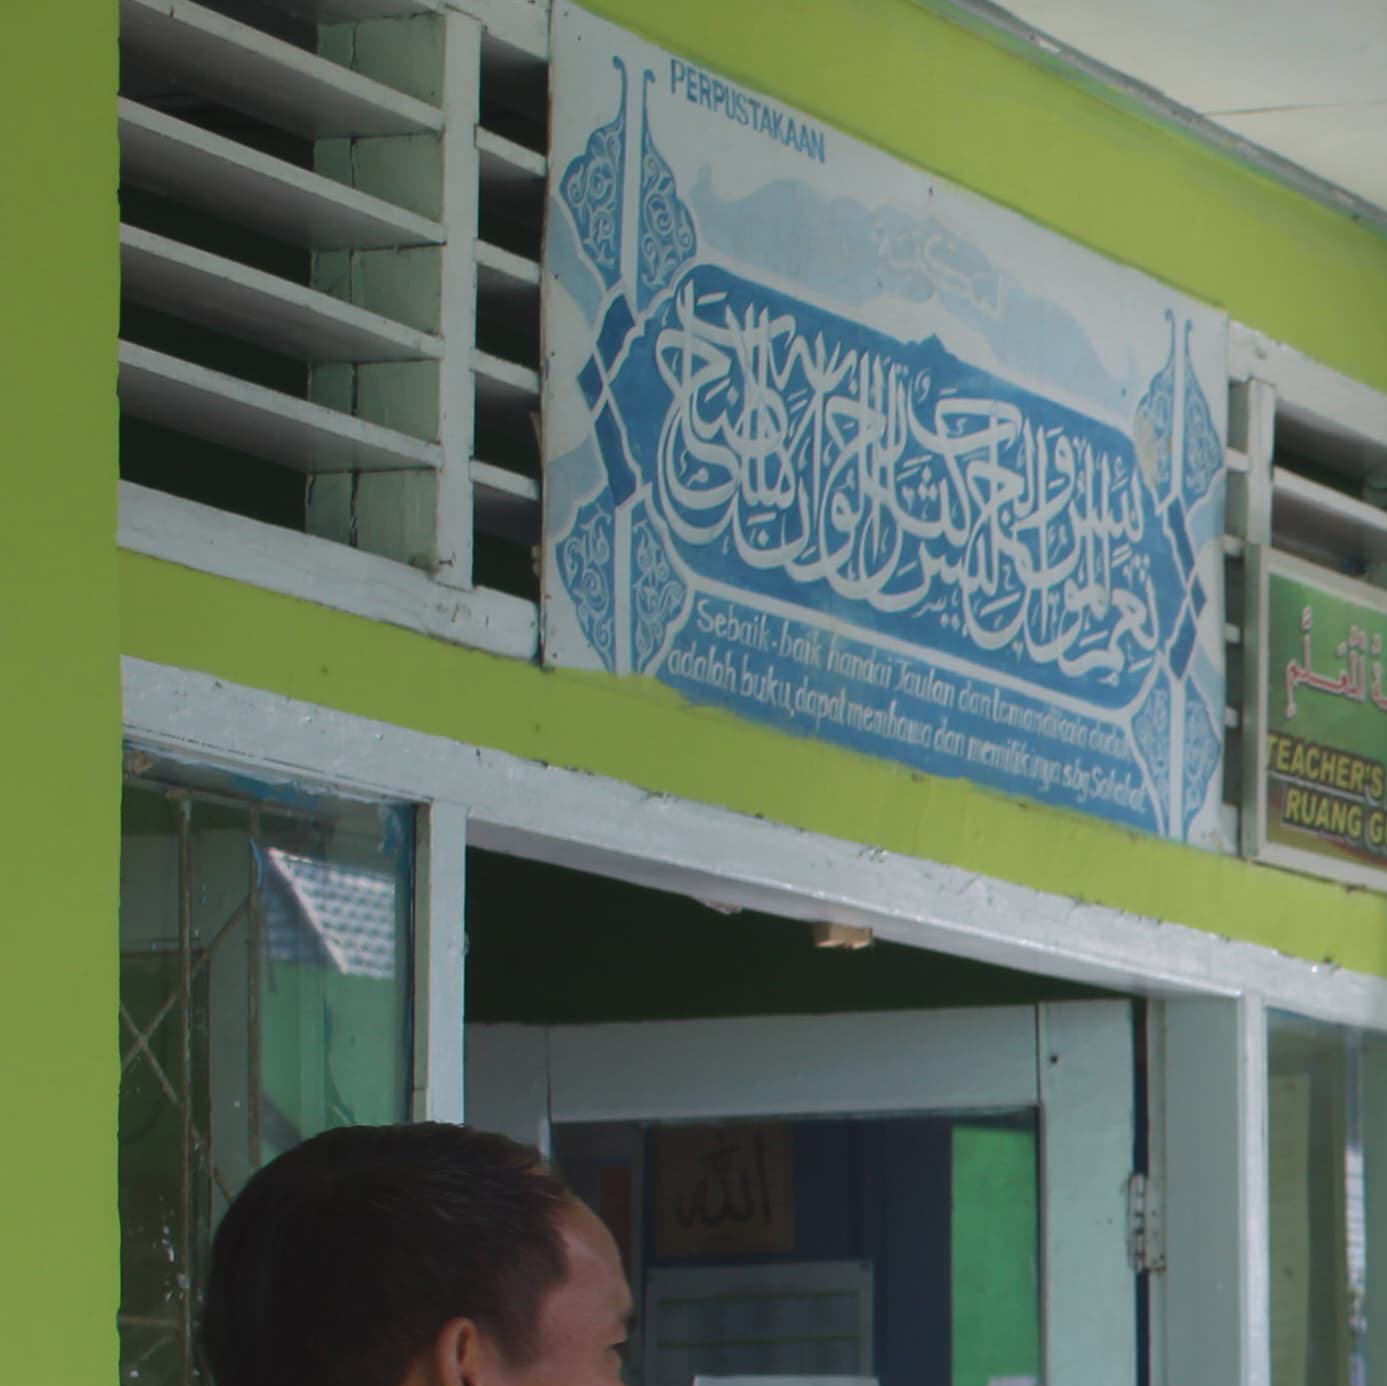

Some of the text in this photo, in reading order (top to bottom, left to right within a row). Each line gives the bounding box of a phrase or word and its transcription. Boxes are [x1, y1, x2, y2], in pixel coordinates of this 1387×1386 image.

[670, 57, 826, 165] PERPUSTAKAAN
[667, 640, 738, 693] adalah
[795, 675, 846, 731] dapat
[933, 717, 966, 758] dan
[1267, 733, 1383, 798] TEACHER'S
[1285, 787, 1363, 838] RUANG
